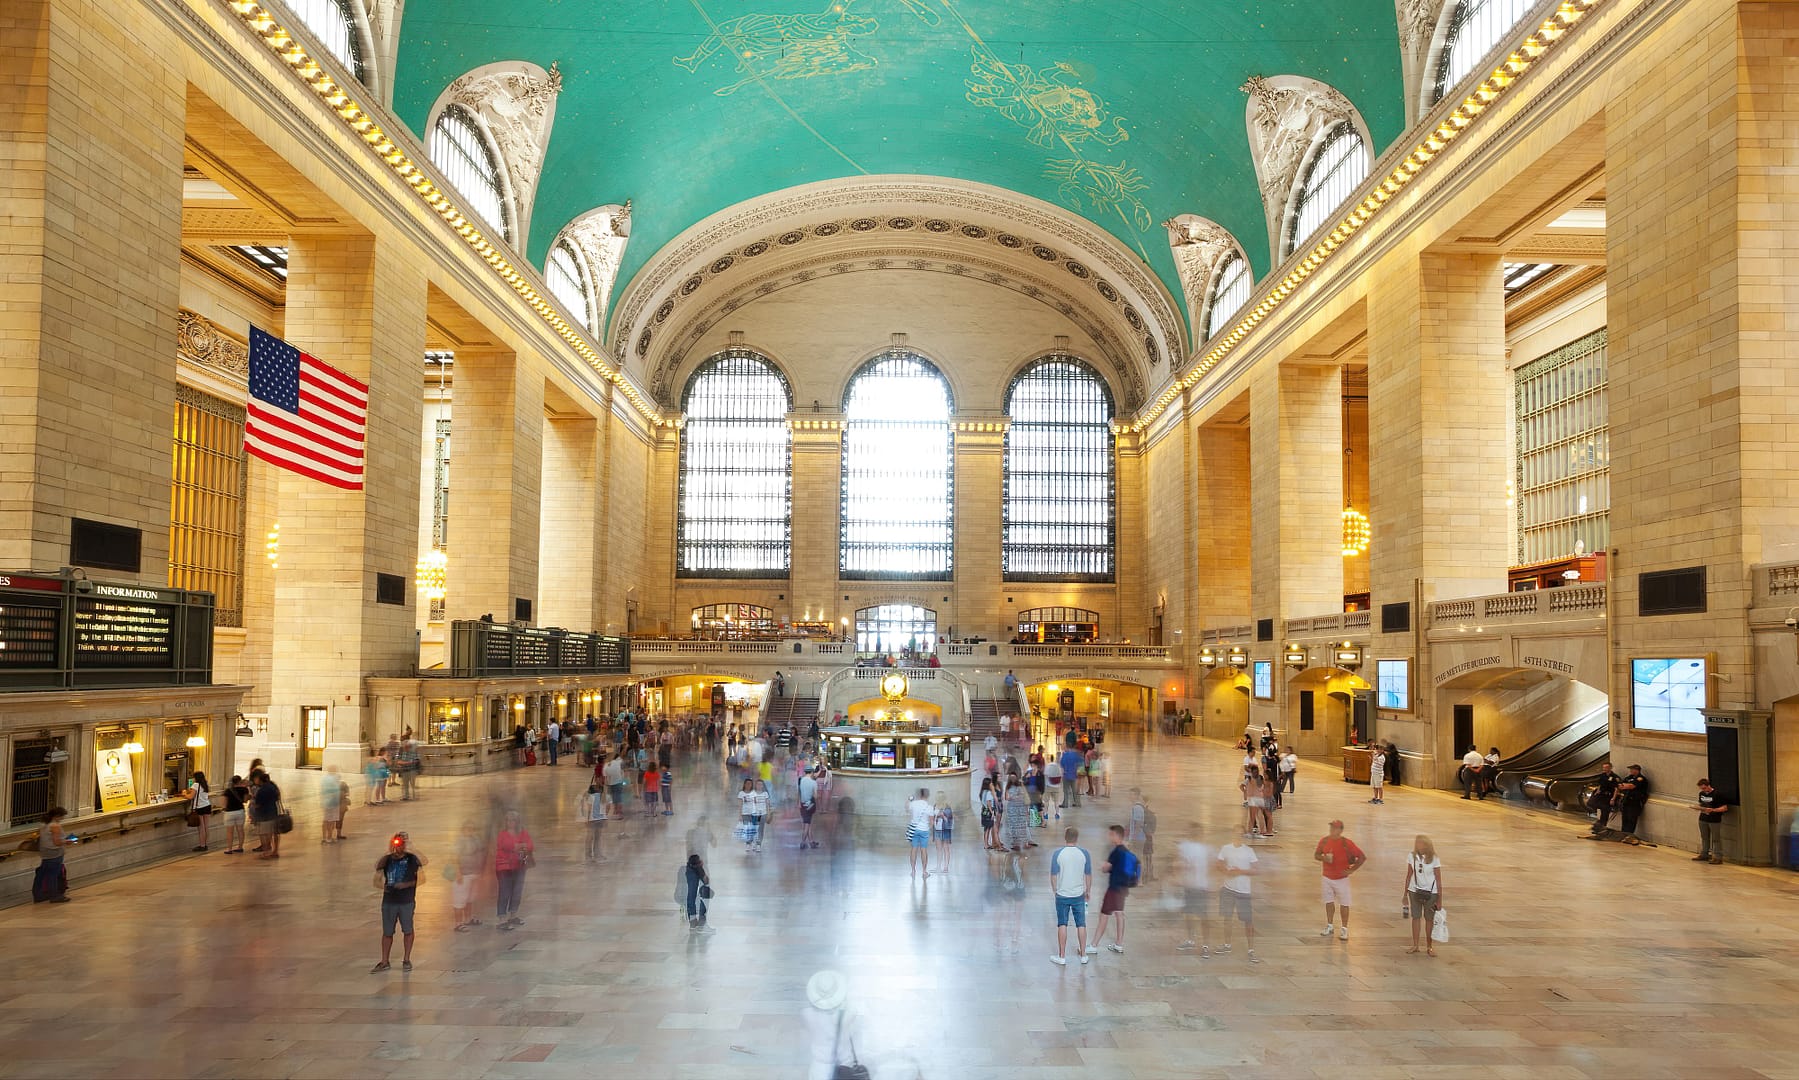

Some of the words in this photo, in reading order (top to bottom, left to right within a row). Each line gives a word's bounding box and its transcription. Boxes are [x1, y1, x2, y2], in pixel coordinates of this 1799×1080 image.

[97, 585, 158, 600] INFORMATION
[78, 643, 95, 651] Thank
[1435, 672, 1446, 684] THE
[1471, 655, 1501, 669] BUILDING
[1524, 656, 1542, 667] 45TH
[1543, 657, 1574, 674] STREET
